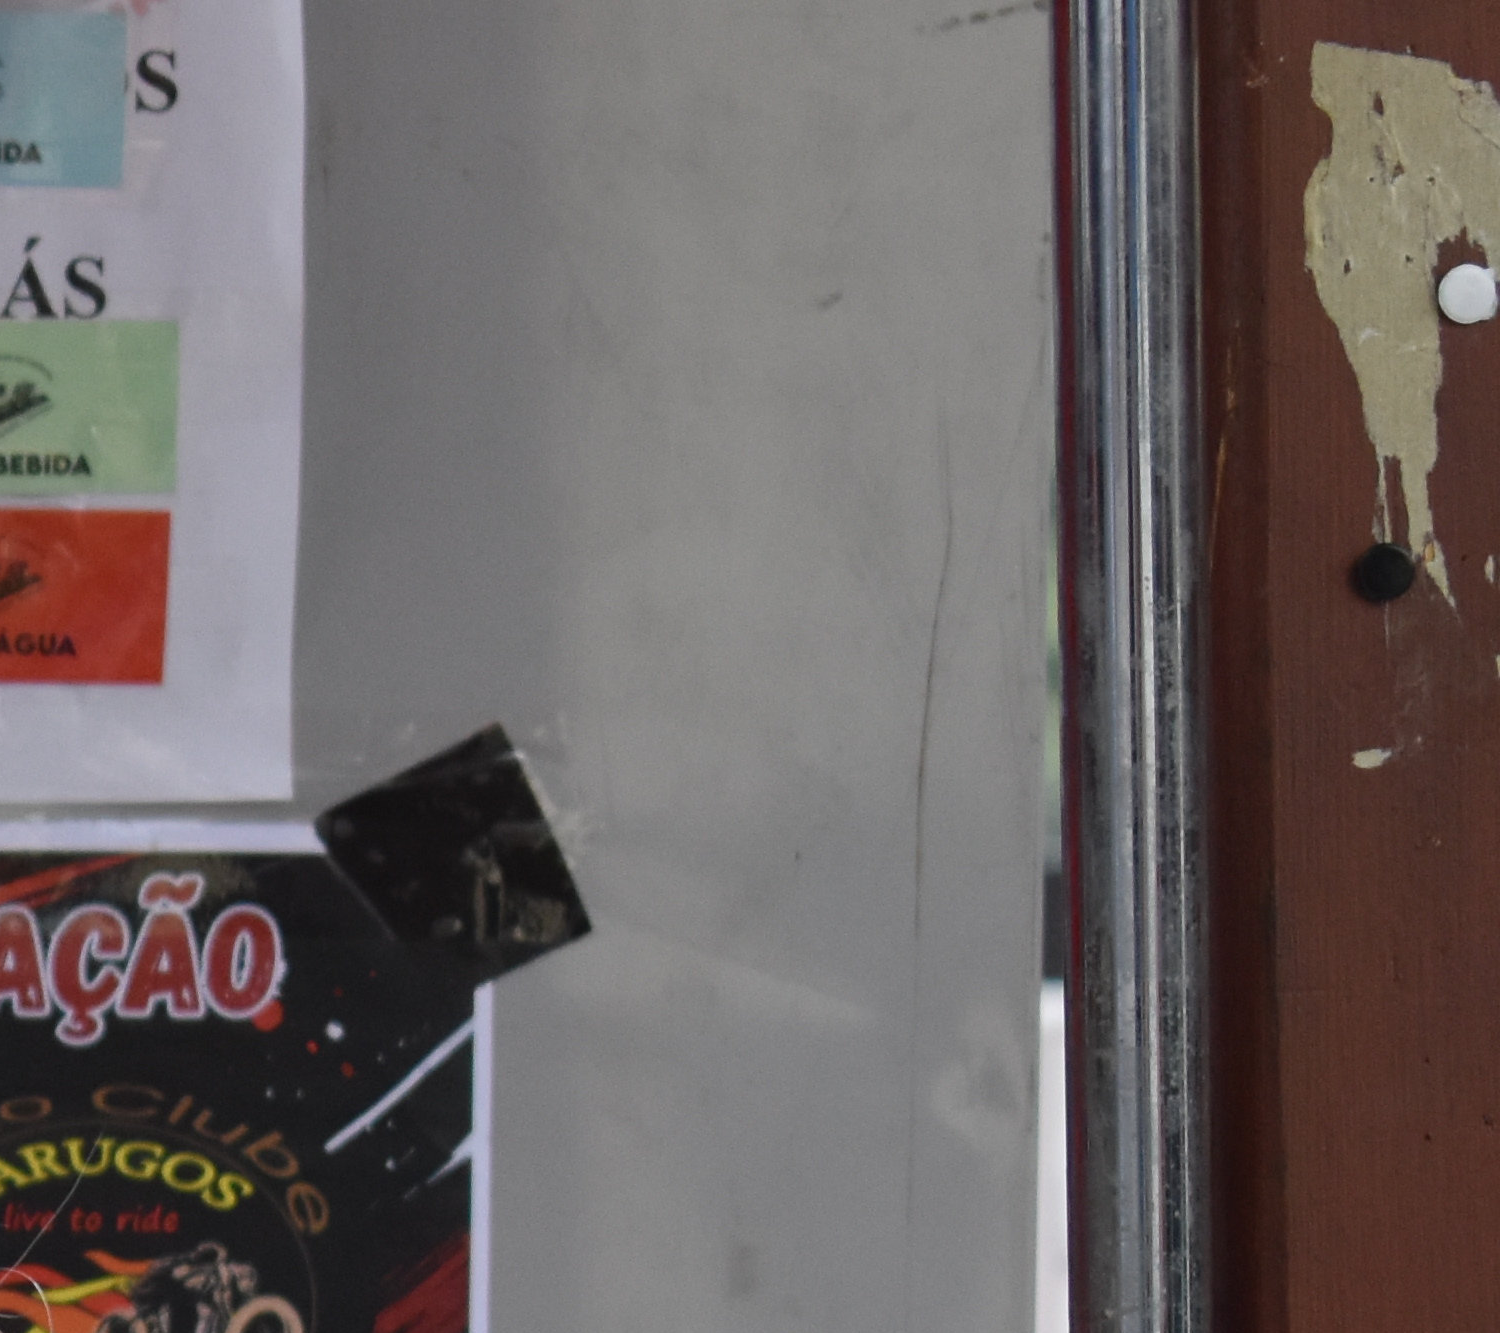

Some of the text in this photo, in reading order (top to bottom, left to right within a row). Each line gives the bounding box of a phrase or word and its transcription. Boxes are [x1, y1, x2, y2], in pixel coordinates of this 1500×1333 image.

[91, 1083, 330, 1236] Clube
[5, 1203, 180, 1233] live to ride
